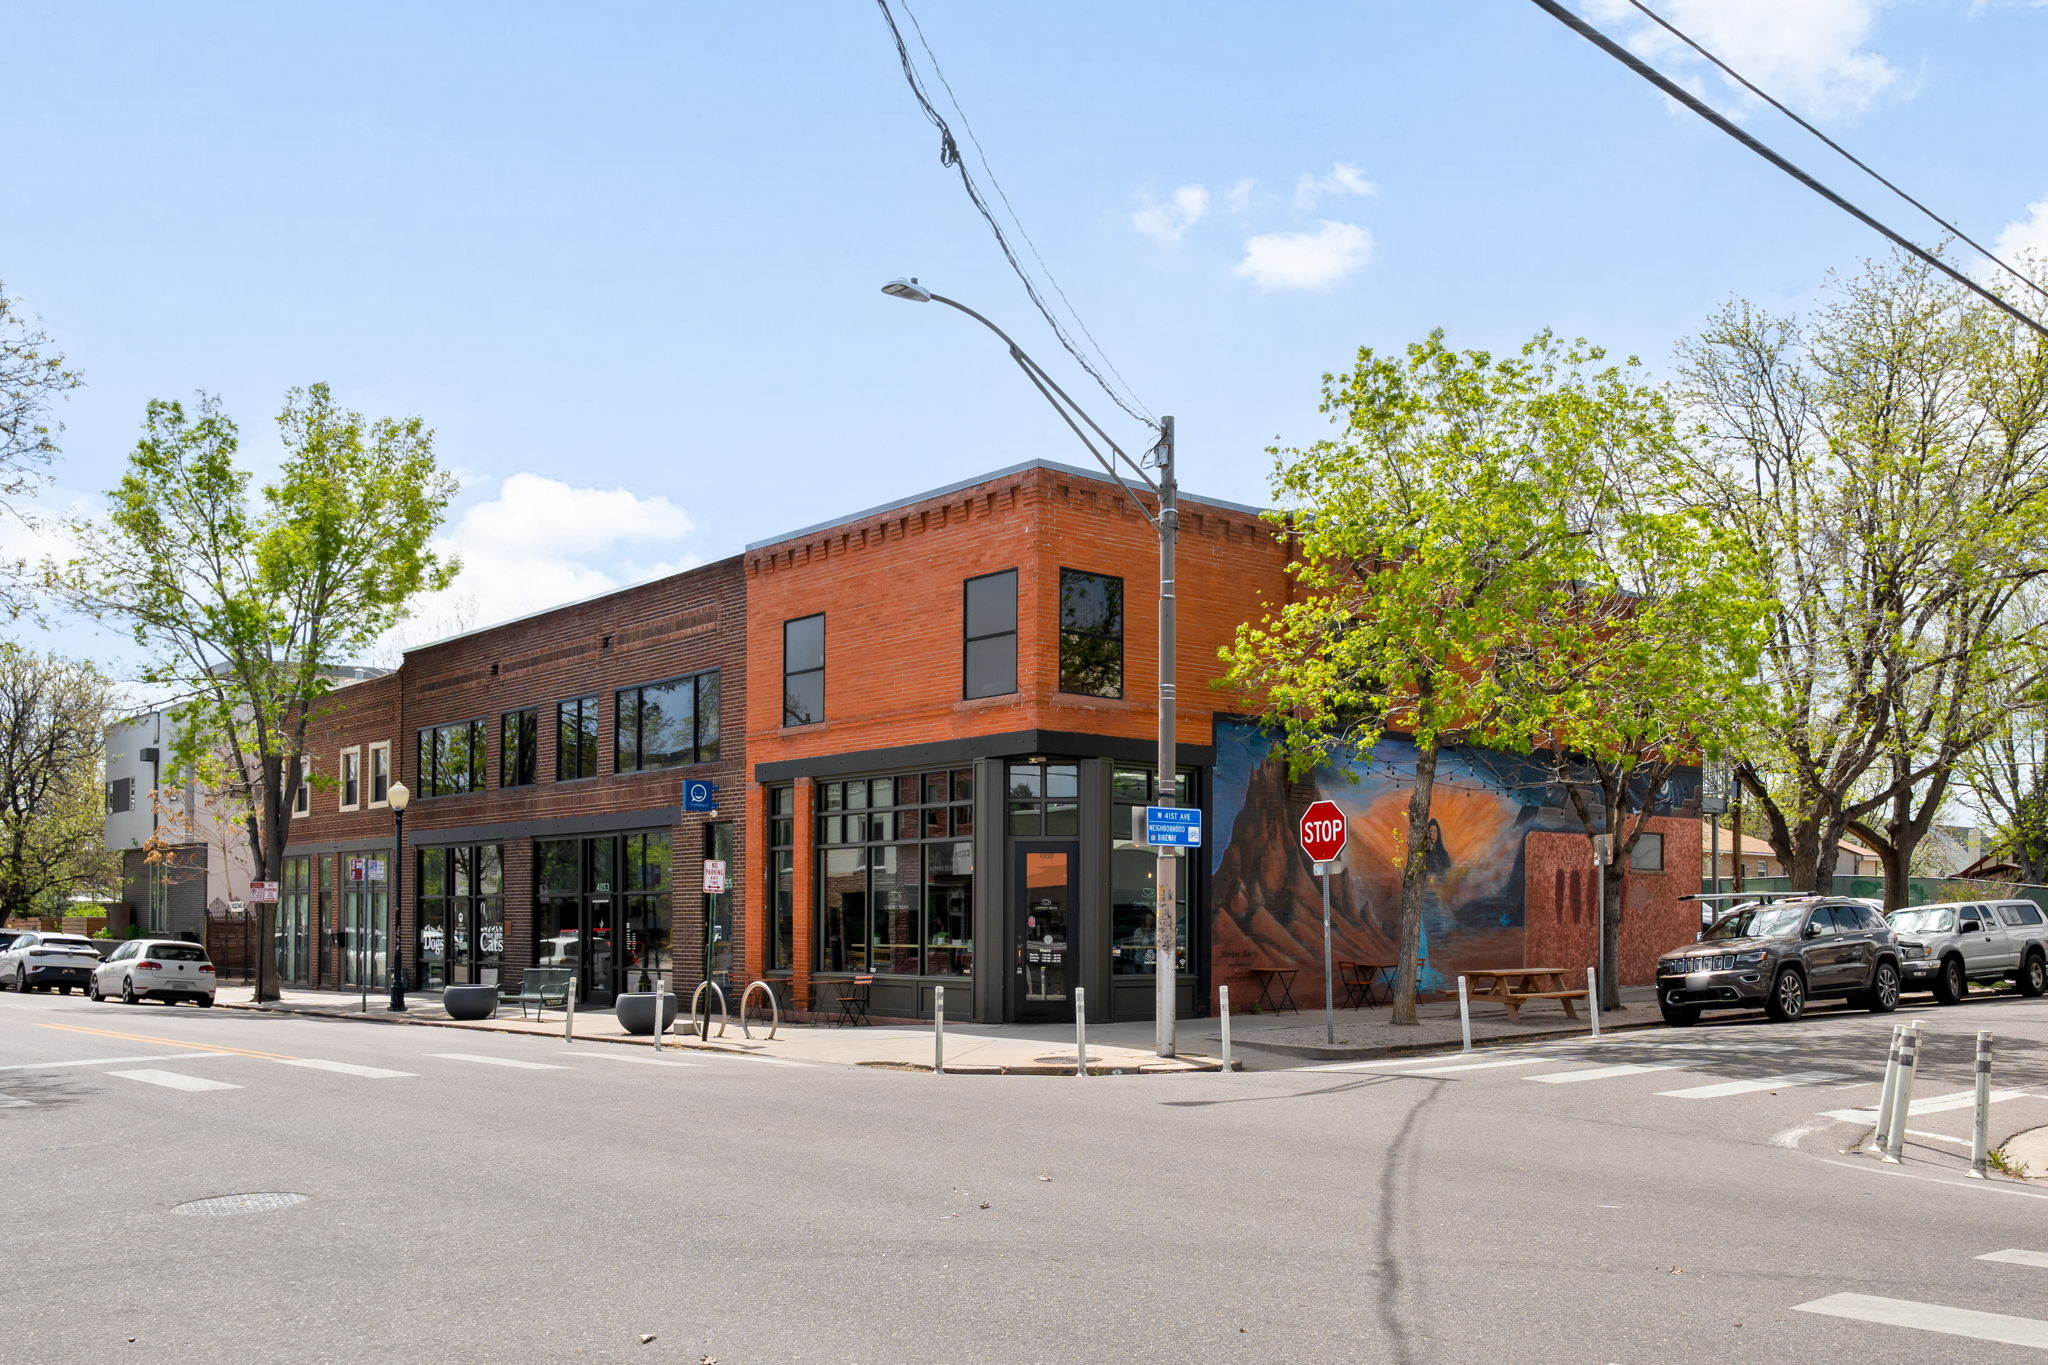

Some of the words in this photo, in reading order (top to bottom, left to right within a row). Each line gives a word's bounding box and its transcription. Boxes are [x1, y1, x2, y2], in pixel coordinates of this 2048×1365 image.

[1164, 812, 1178, 820] 41ST
[1149, 824, 1186, 833] NEIGHBORHOOD
[1304, 819, 1343, 844] STOP
[1157, 834, 1177, 842] BIKEWAY
[596, 882, 610, 892] 4053
[423, 936, 444, 955] Dogs
[480, 932, 504, 952] Cats
